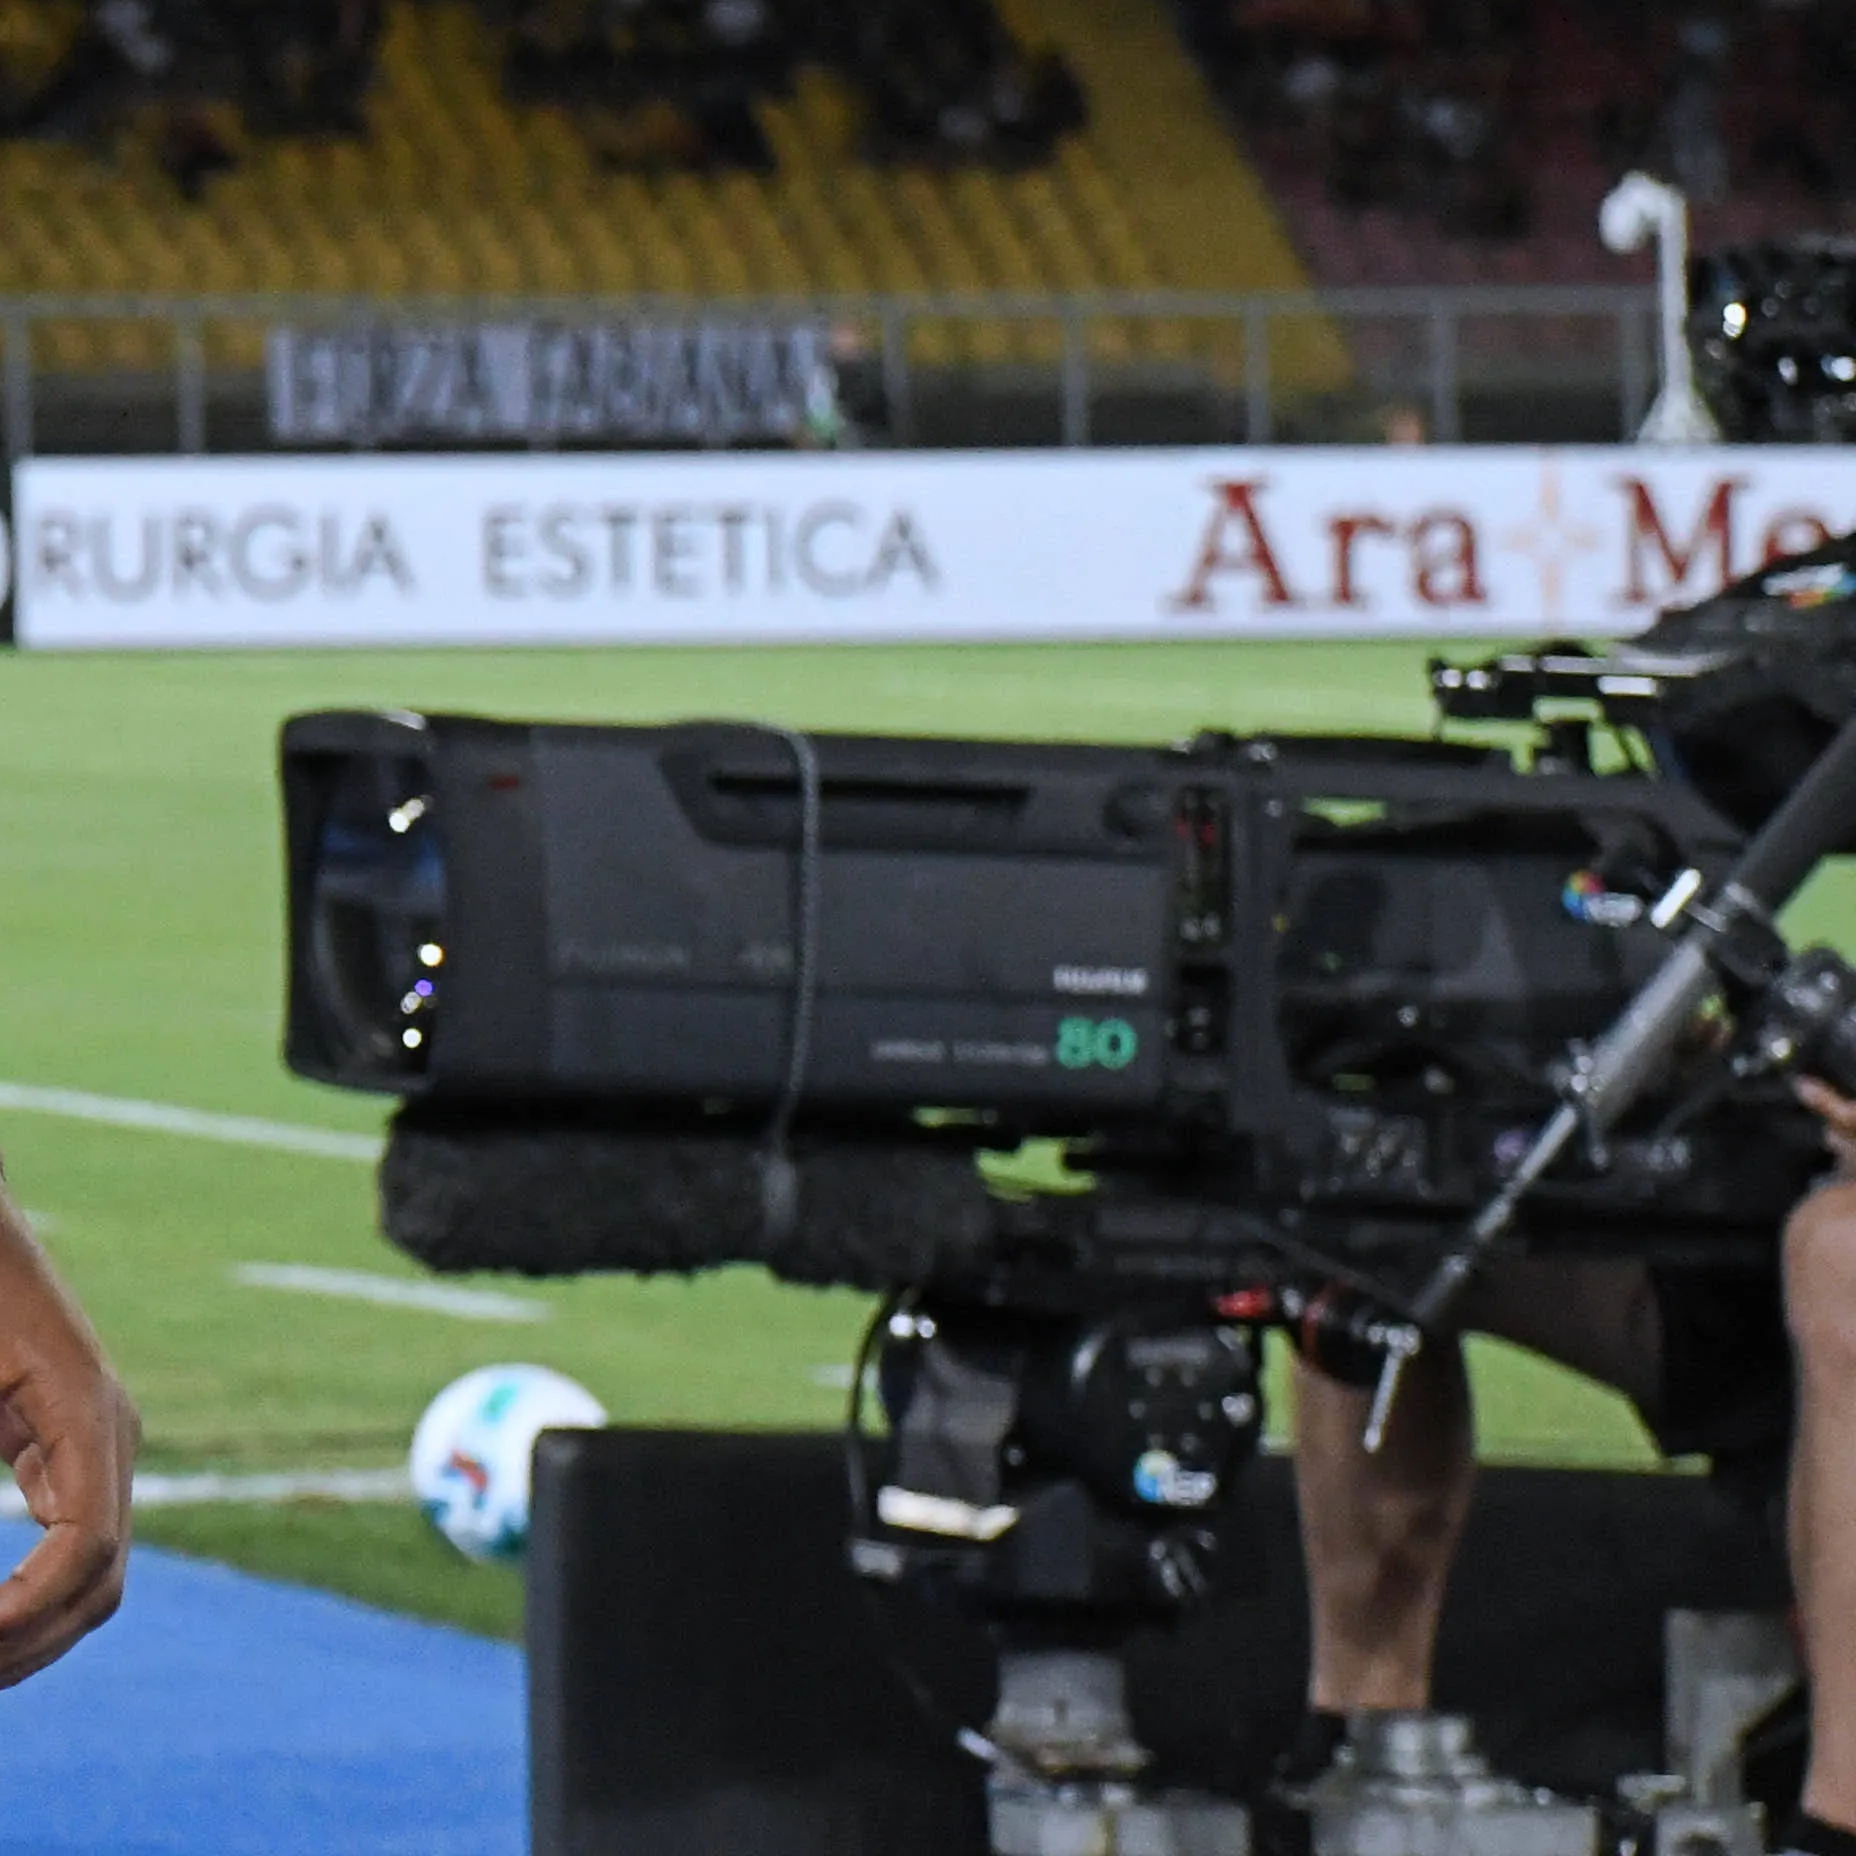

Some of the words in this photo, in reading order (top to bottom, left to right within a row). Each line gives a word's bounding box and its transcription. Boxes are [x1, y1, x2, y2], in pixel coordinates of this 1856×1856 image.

[478, 497, 944, 602] ESTETICA
[1162, 470, 1494, 614] Ara
[1053, 1014, 1139, 1071] 80
